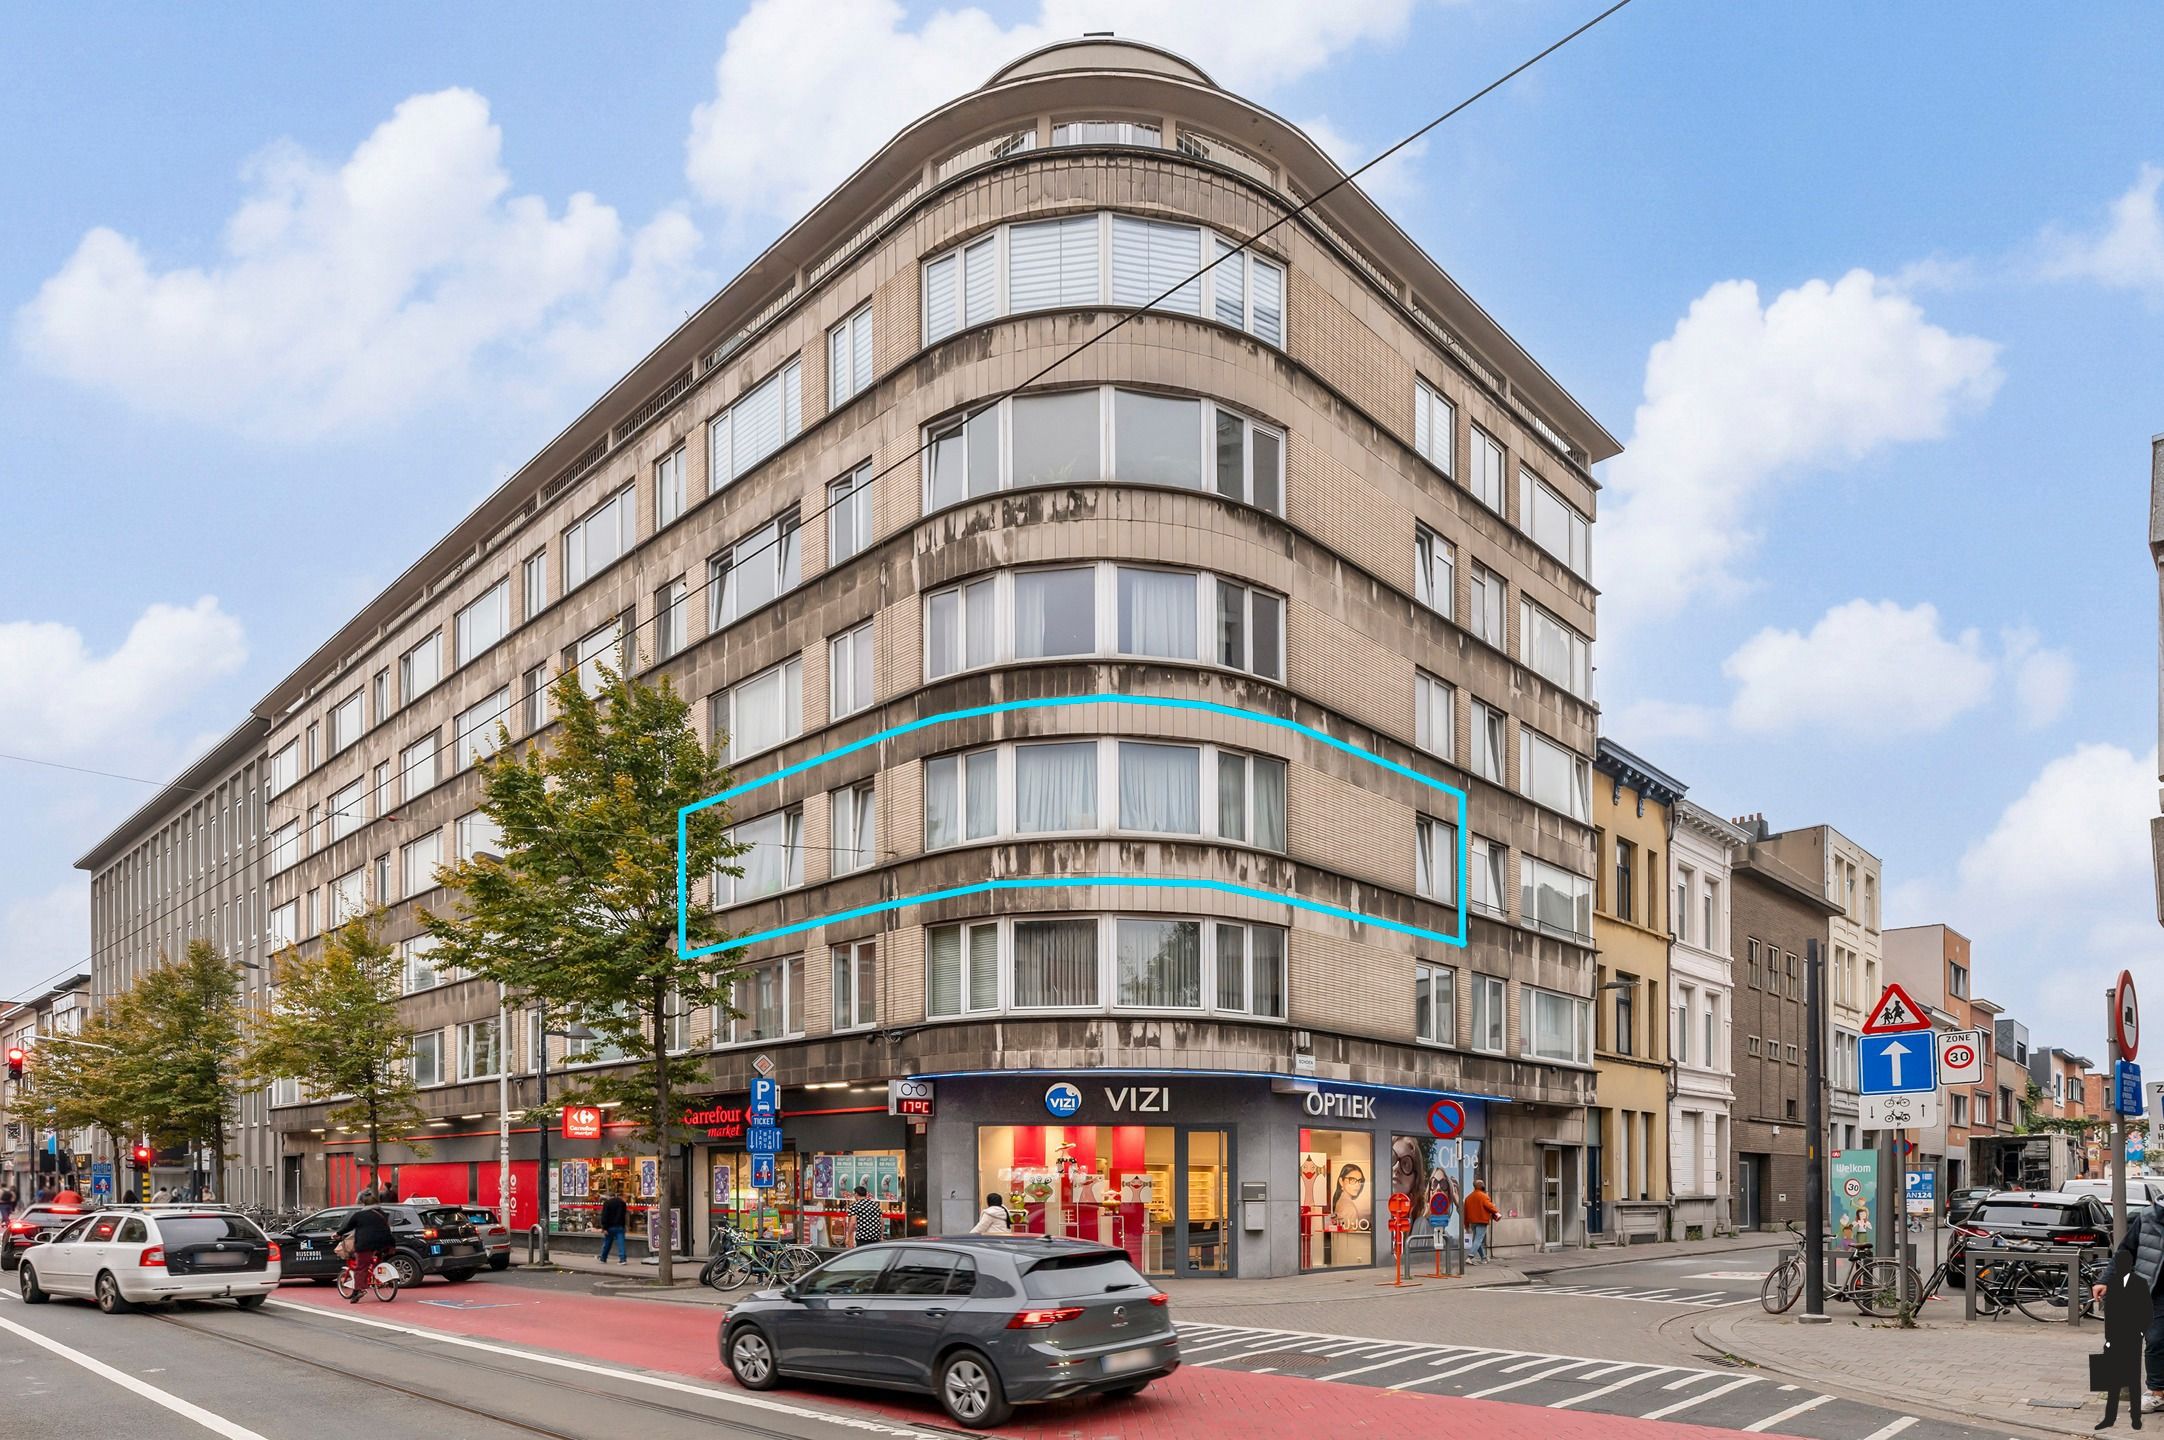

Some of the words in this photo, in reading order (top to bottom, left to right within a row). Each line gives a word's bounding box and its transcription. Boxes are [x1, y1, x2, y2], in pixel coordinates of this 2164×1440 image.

[1946, 1034, 1971, 1042] ZONE
[1950, 1051, 1969, 1062] 30
[757, 1080, 770, 1100] P
[1050, 1098, 1075, 1108] VIZI
[1104, 1087, 1169, 1112] VIZI
[1303, 1092, 1376, 1119] OPTIEK
[683, 1105, 742, 1125] Carrefour
[707, 1124, 740, 1137] market
[1438, 1146, 1479, 1169] Choé
[1836, 1164, 1871, 1173] Welkom
[1847, 1183, 1859, 1191] 30
[1906, 1173, 1920, 1190] P
